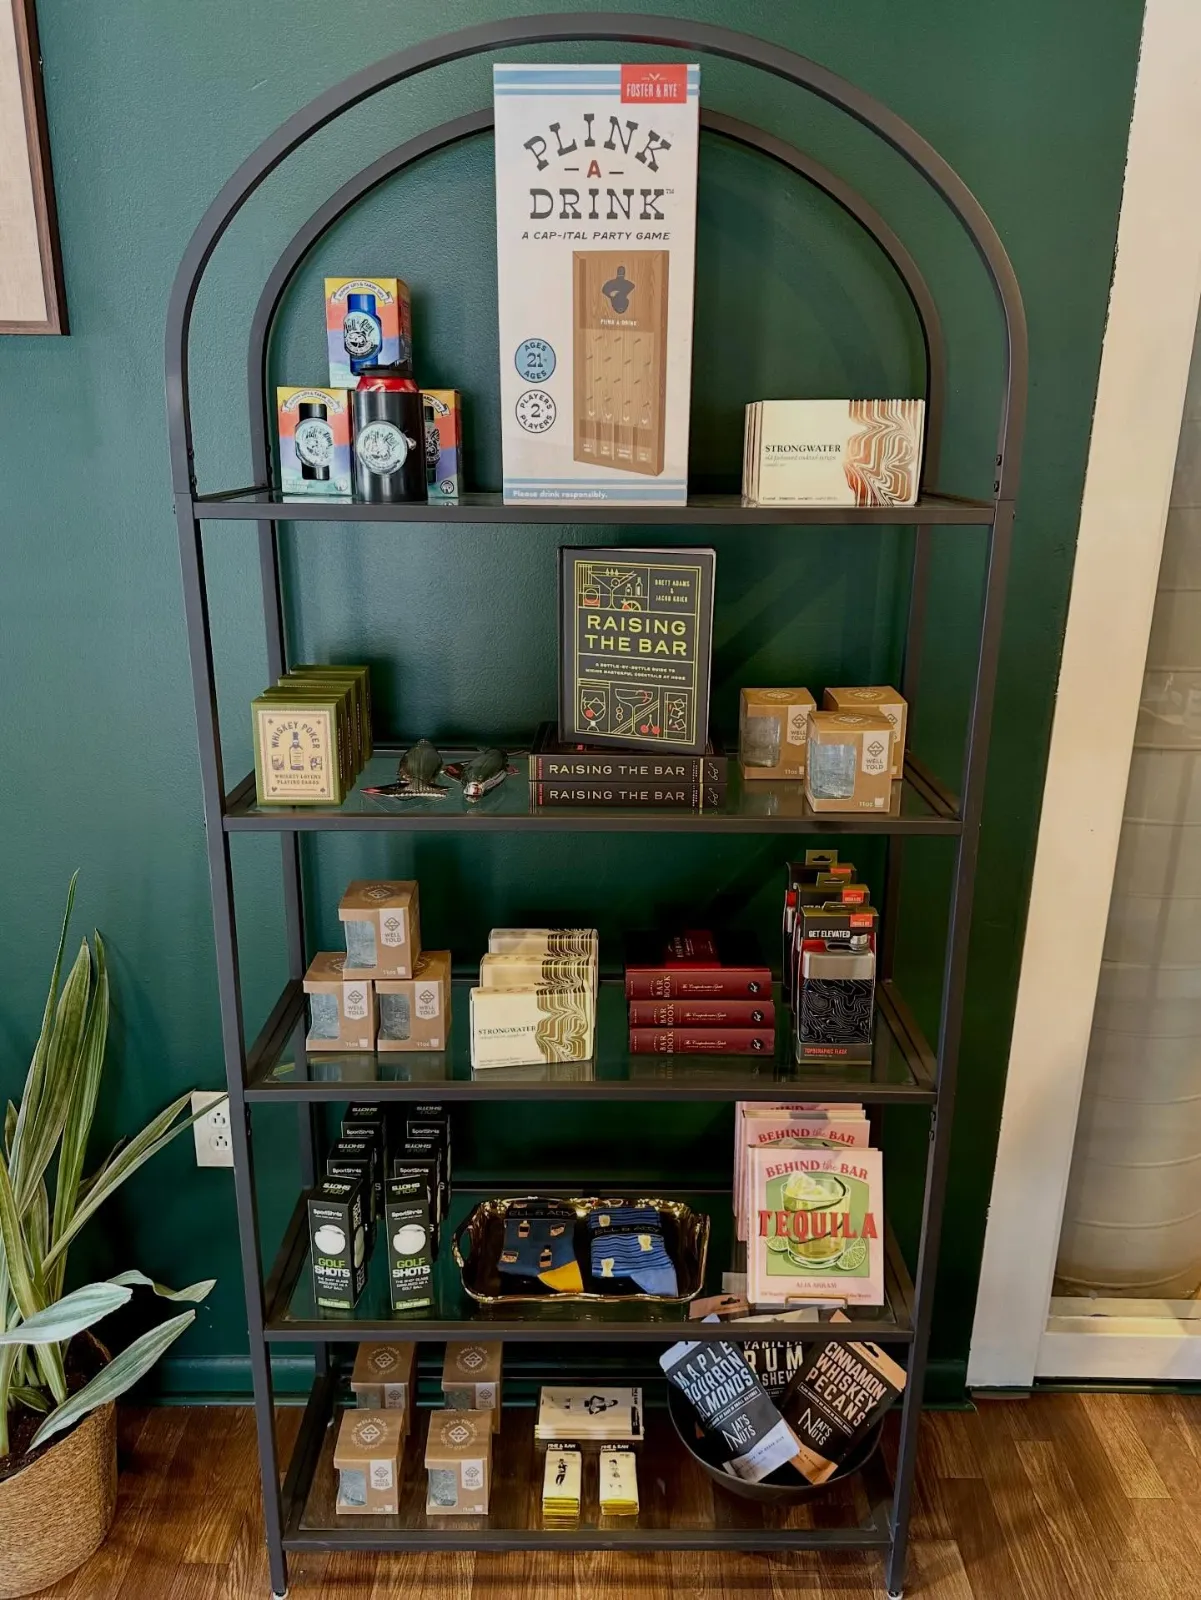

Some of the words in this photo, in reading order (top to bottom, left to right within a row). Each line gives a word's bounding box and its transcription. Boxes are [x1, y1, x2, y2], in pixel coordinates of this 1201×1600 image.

[627, 84, 653, 97] FOSTER
[656, 85, 661, 97] &
[664, 85, 677, 97] RYE
[523, 113, 672, 172] PLINK
[530, 188, 664, 220] DRINK
[593, 232, 632, 240] PARTY
[636, 232, 670, 240] GAME
[525, 342, 547, 351] AGES
[524, 370, 546, 379] AGES
[520, 393, 552, 409] PLAYERS
[520, 414, 552, 429] PLAYERS
[587, 615, 686, 635] RAISING
[584, 635, 631, 652] THE
[639, 638, 687, 656] BAR
[272, 722, 299, 748] WHISKEY
[301, 724, 320, 748] POKER
[550, 765, 612, 775] RAISING
[618, 766, 648, 775] THE
[654, 766, 685, 776] BAR
[550, 791, 613, 800] RAISING
[619, 791, 648, 800] THE
[654, 792, 685, 800] BAR
[821, 930, 850, 938] ELEVATED
[478, 1026, 536, 1034] STRONGWATER
[758, 1129, 810, 1143] BEHIND
[812, 1128, 826, 1137] the
[829, 1131, 855, 1144] BAR
[765, 1160, 820, 1178] BEHIND
[822, 1159, 837, 1171] the
[840, 1163, 868, 1180] BAR
[758, 1210, 878, 1240] TEQUILA
[318, 1258, 345, 1268] GOLF
[397, 1258, 425, 1268] GOLF
[314, 1265, 350, 1278] SHOTS
[392, 1265, 430, 1278] SHOTS
[673, 1341, 732, 1390] MAPLE
[744, 1345, 803, 1376] RUM
[825, 1341, 887, 1400] CINNAMON
[815, 1353, 877, 1413] WHISKEY
[696, 1368, 753, 1422] ALMONDS
[805, 1367, 866, 1427] PECANS
